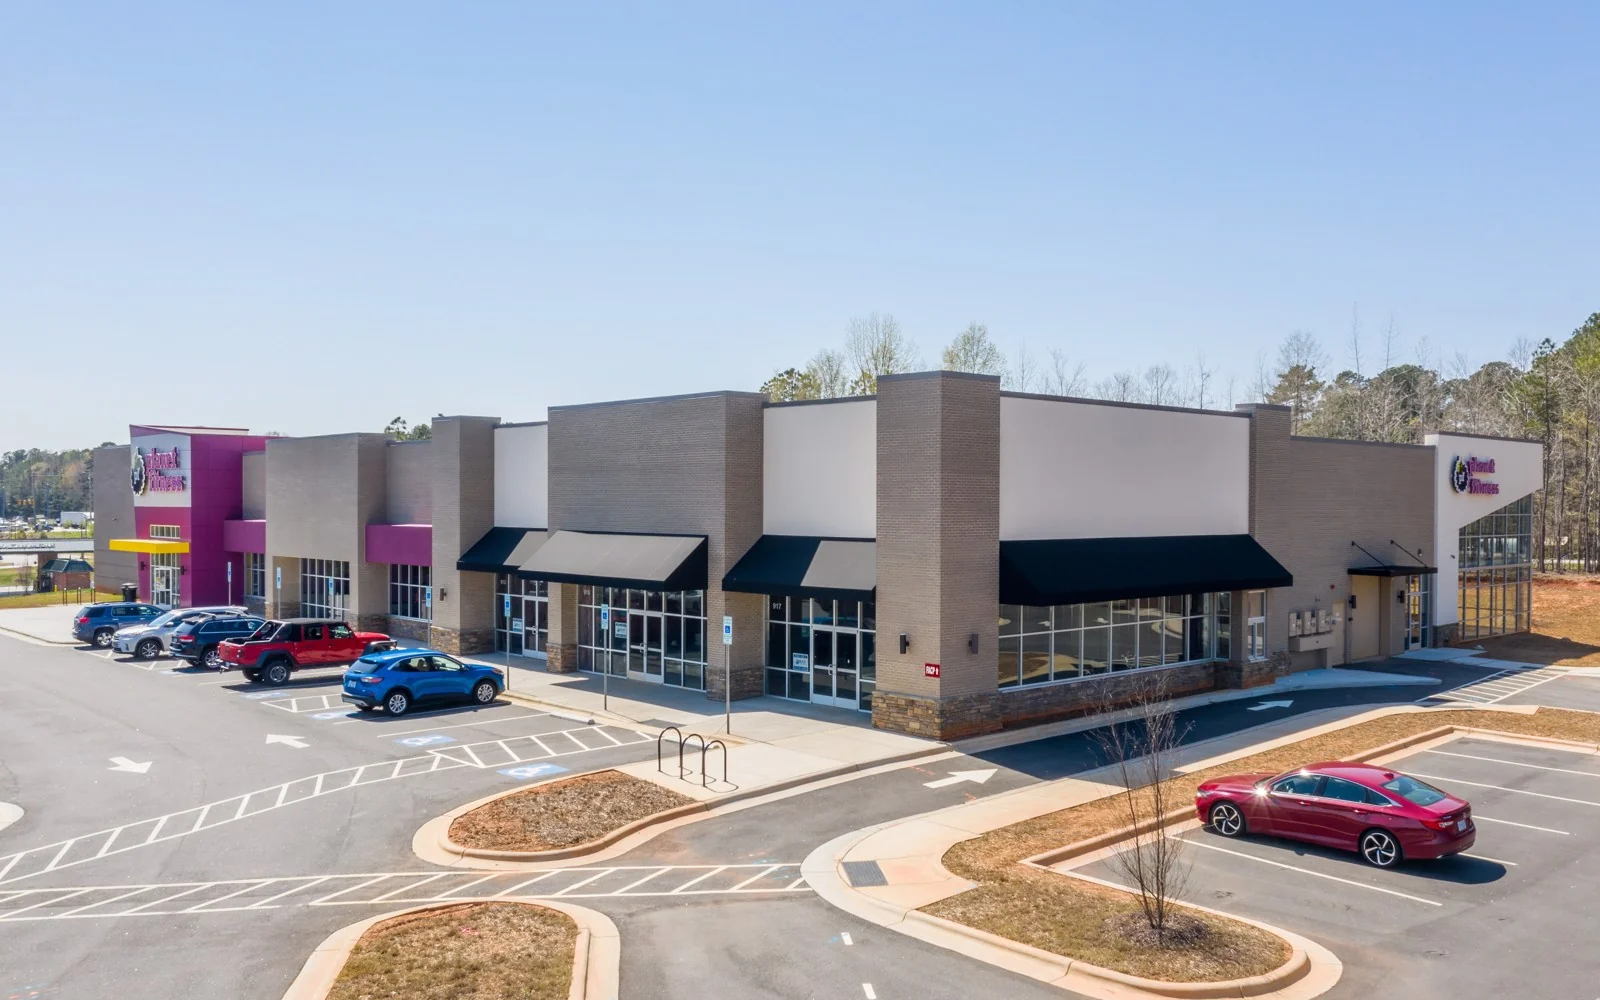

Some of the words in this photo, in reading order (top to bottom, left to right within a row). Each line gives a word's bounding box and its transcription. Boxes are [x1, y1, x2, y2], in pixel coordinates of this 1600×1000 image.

[145, 447, 178, 476] planet
[1467, 456, 1496, 476] planet
[149, 469, 186, 492] fitness
[1469, 478, 1500, 495] fitness
[772, 602, 782, 610] 917
